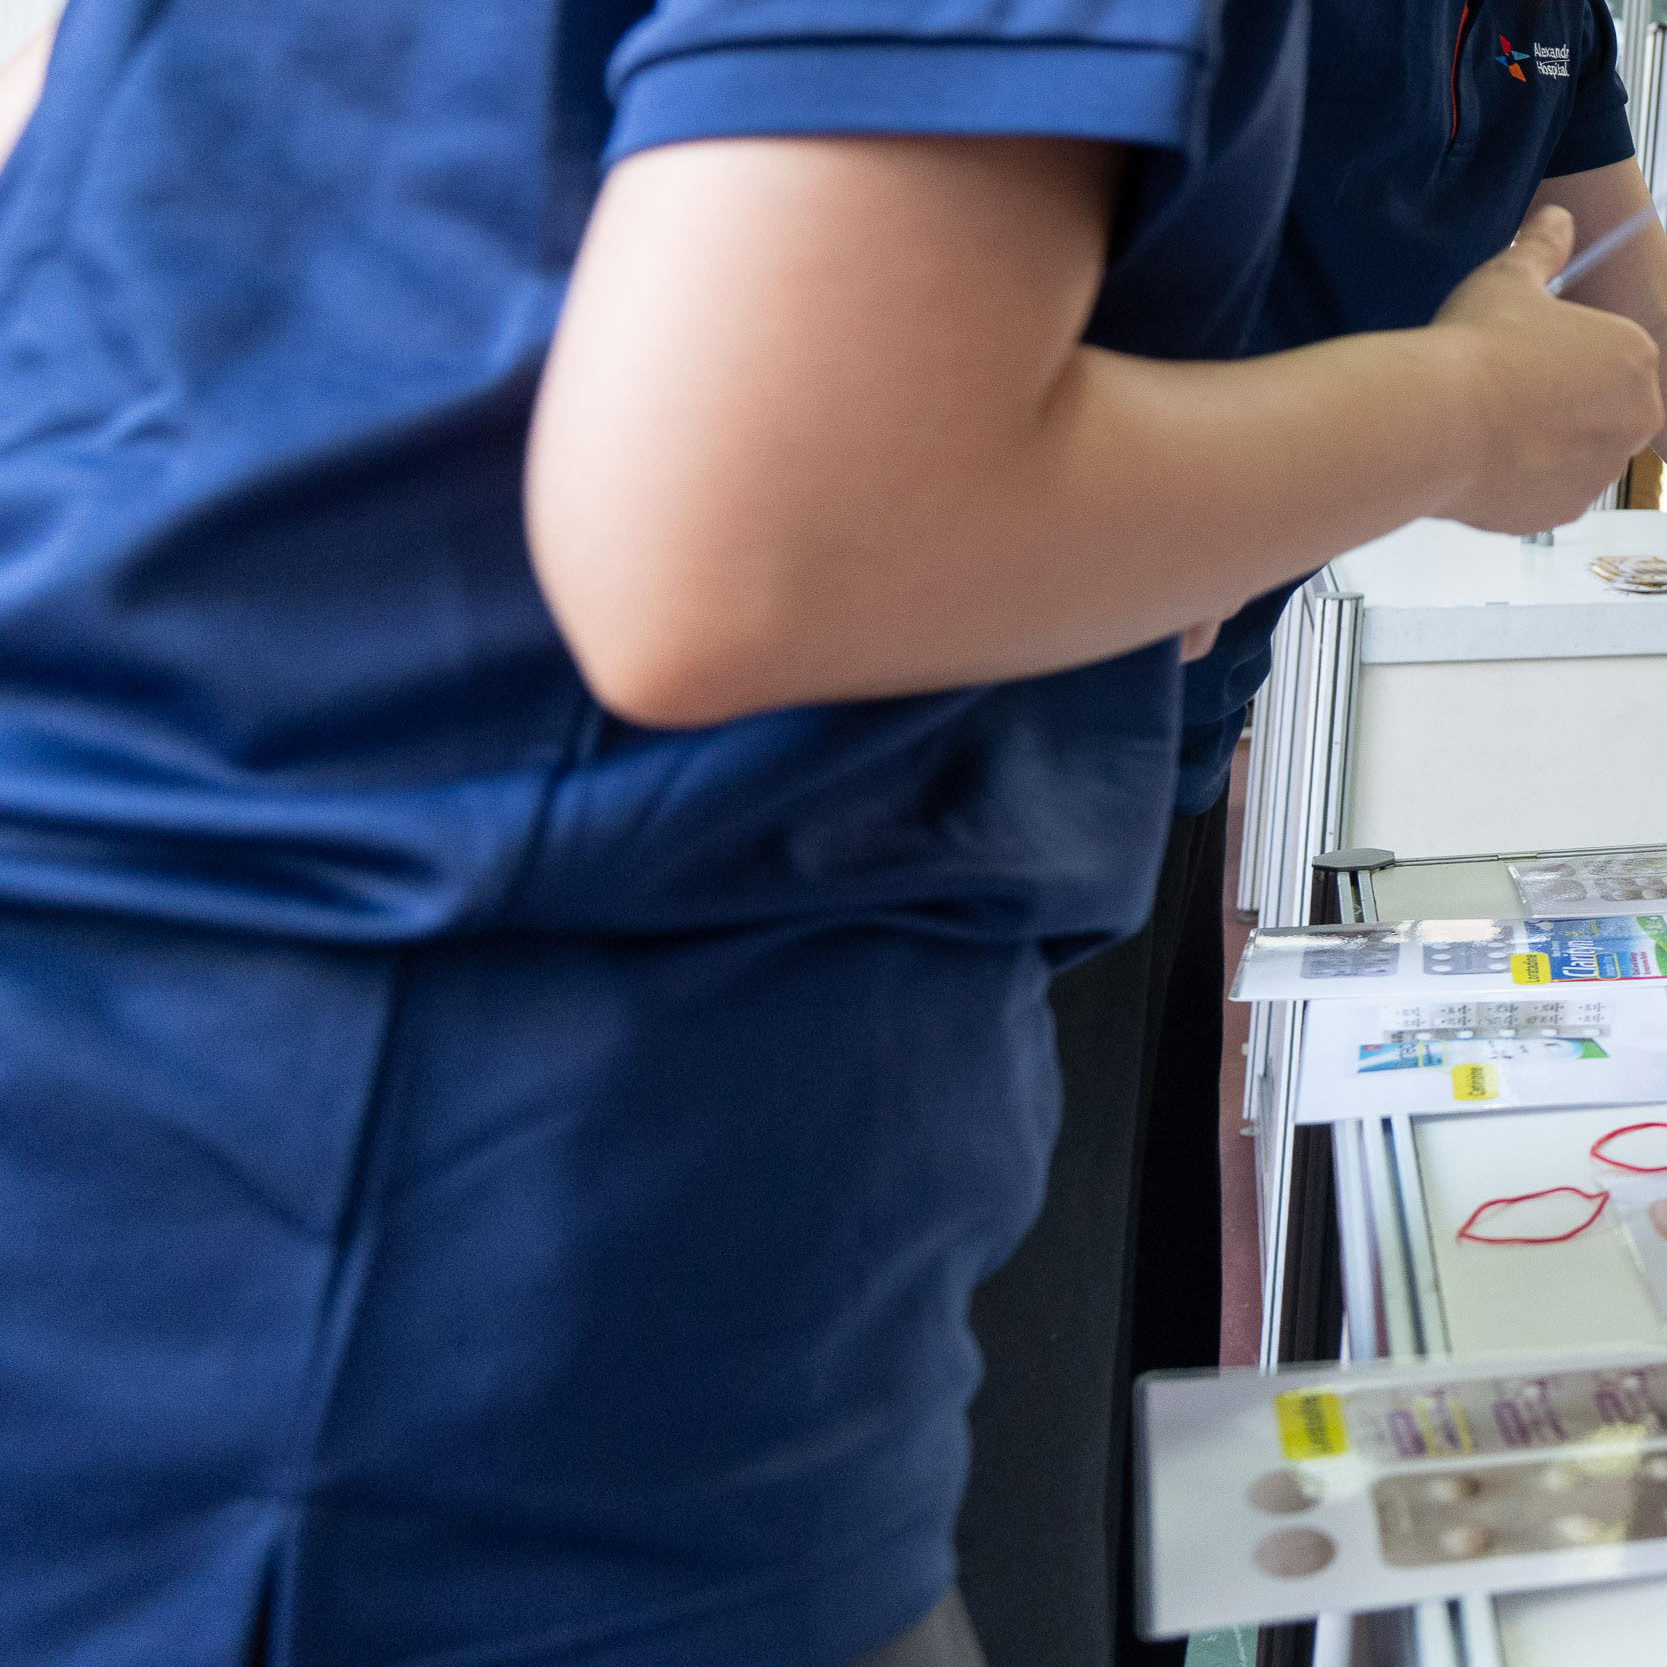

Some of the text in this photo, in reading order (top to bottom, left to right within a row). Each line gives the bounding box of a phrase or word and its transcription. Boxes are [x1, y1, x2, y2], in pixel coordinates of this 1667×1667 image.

[1536, 61, 1570, 80] Hospital
[1526, 954, 1540, 983] Loratadine
[1562, 940, 1604, 978] Clarityn
